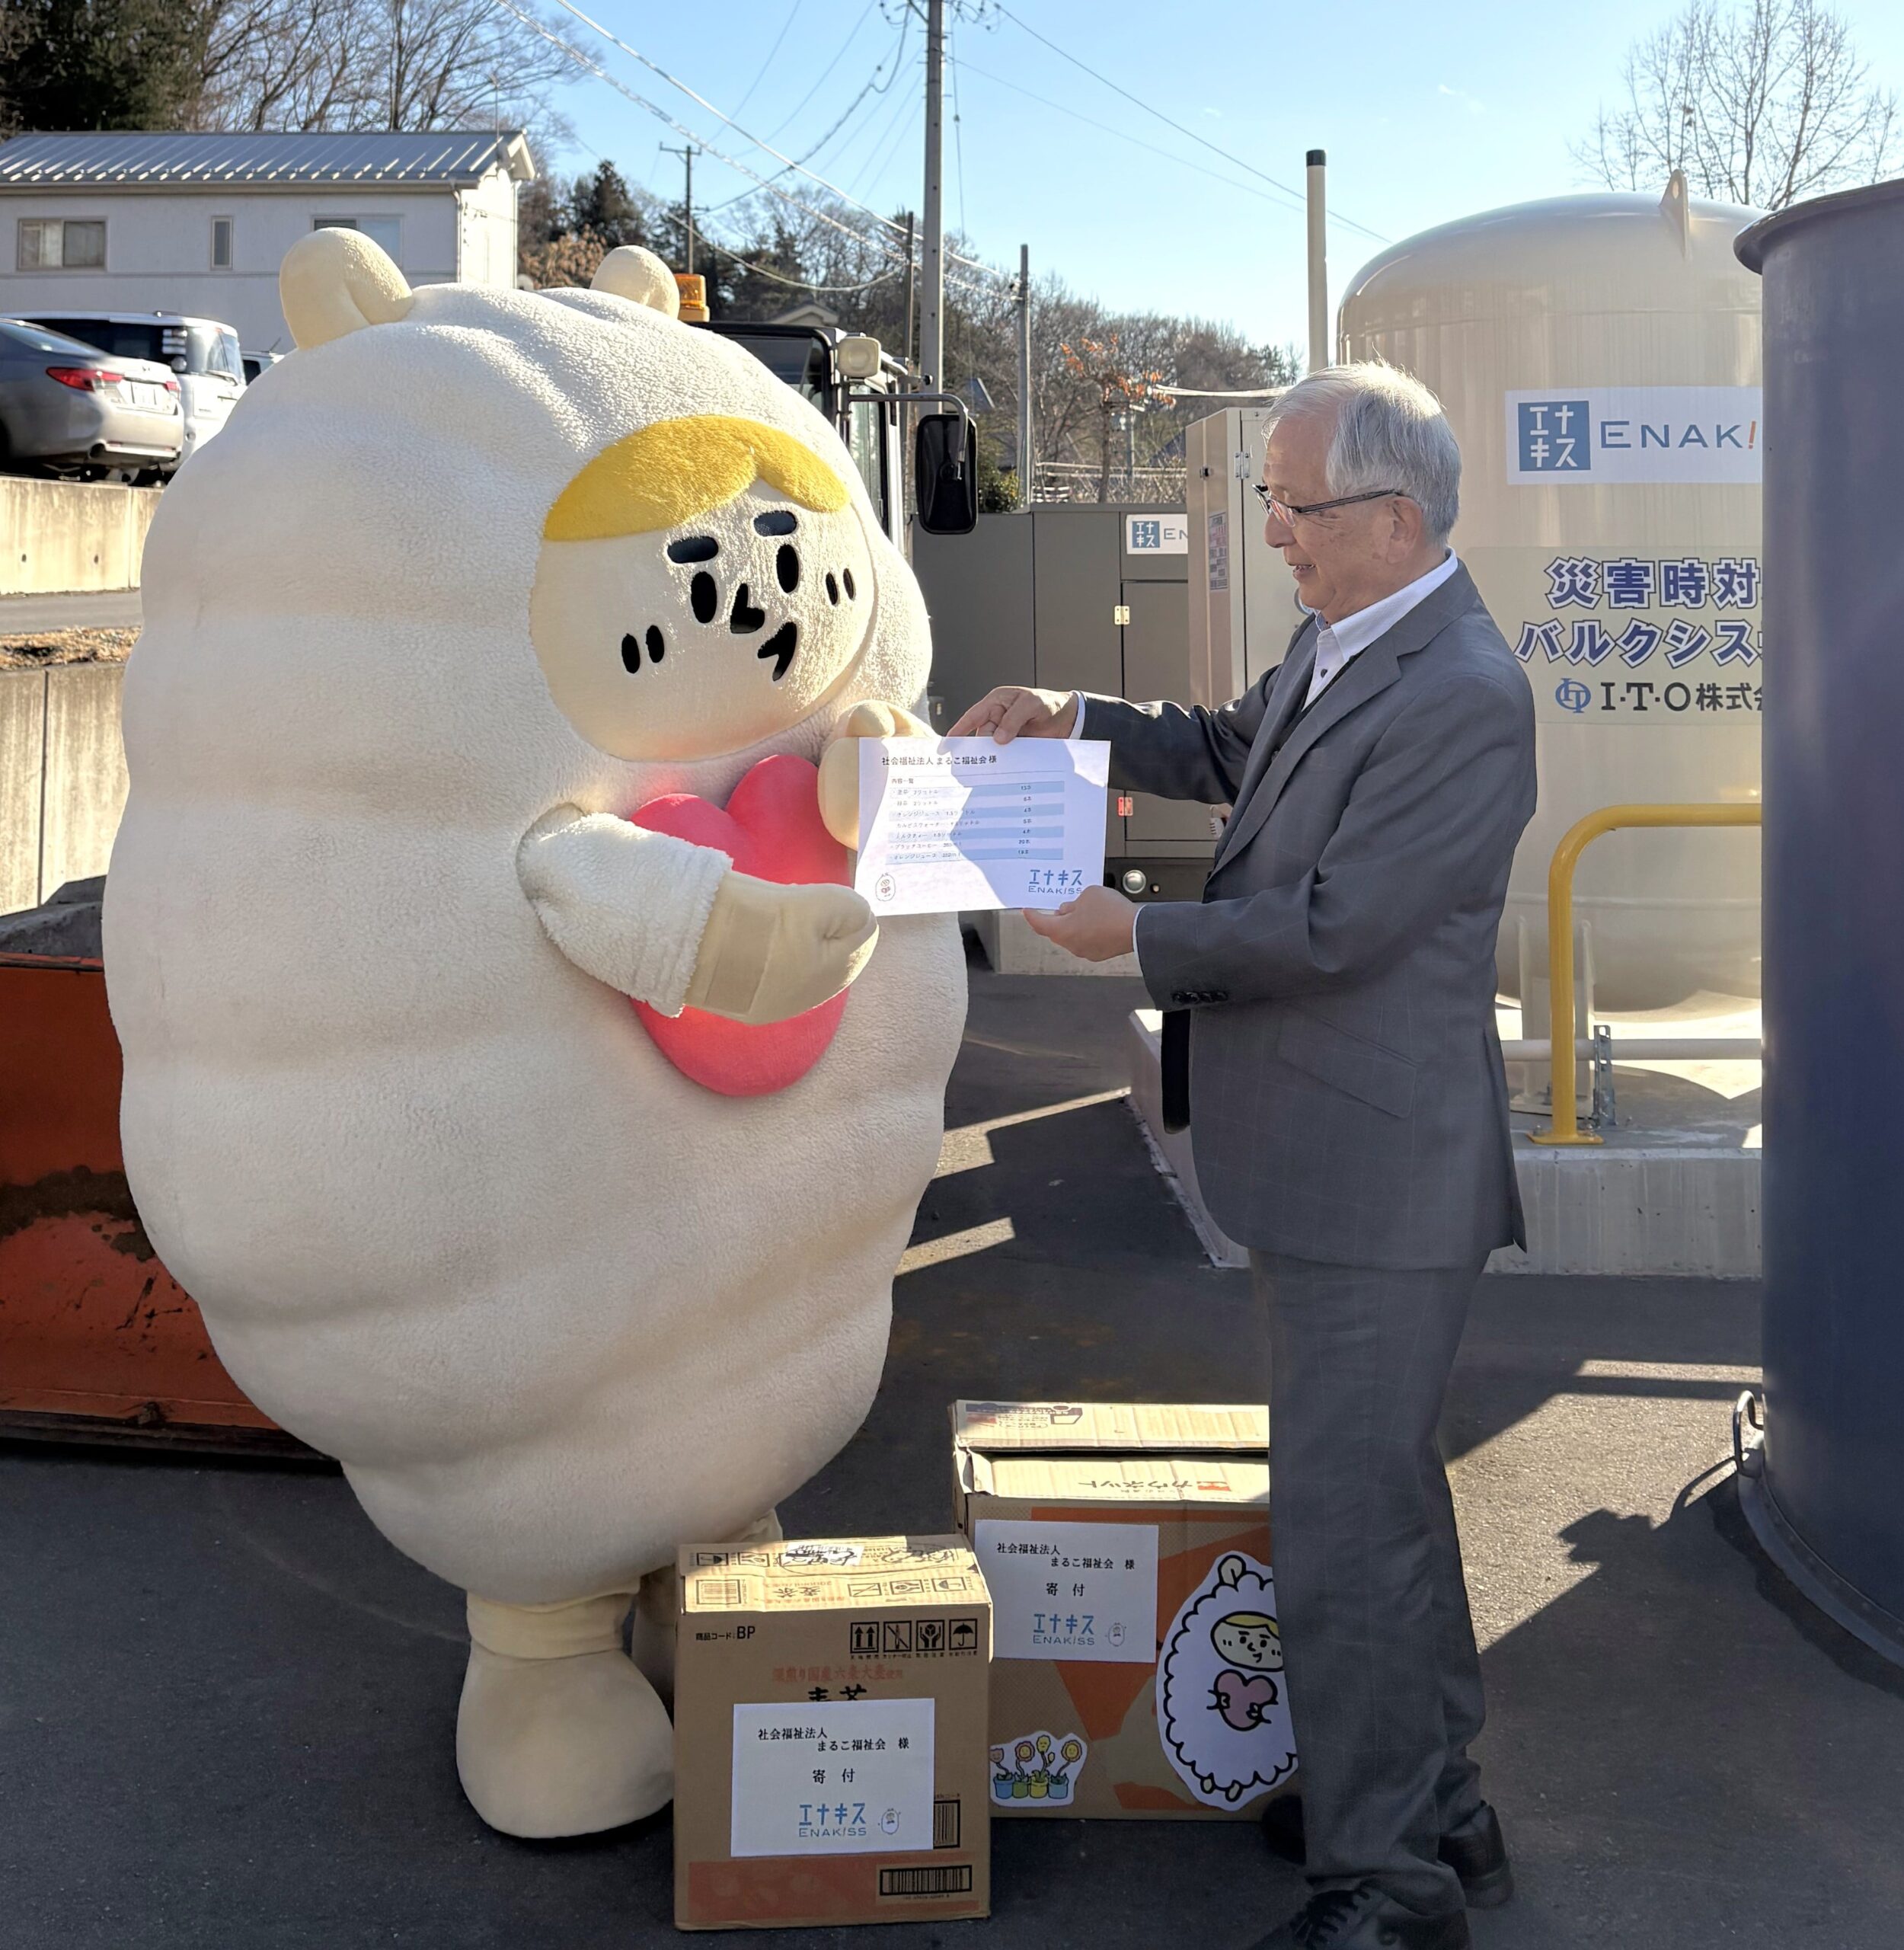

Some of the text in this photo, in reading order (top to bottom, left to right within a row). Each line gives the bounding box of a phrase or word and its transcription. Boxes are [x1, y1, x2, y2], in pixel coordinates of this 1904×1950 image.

[1544, 556, 1761, 610] 災害時対
[1514, 618, 1762, 669] バルクシス
[1029, 869, 1083, 886] エナキス
[1078, 1479, 1193, 1490] カウネット
[996, 1542, 1061, 1555] 社会福祉法人
[1049, 1556, 1136, 1571] まるこ福祉会 様
[1033, 1612, 1095, 1635] エナキス
[758, 1727, 828, 1741] 社会福祉法人
[817, 1737, 910, 1753] まるこ福祉会 様
[799, 1802, 867, 1827] エナキス
